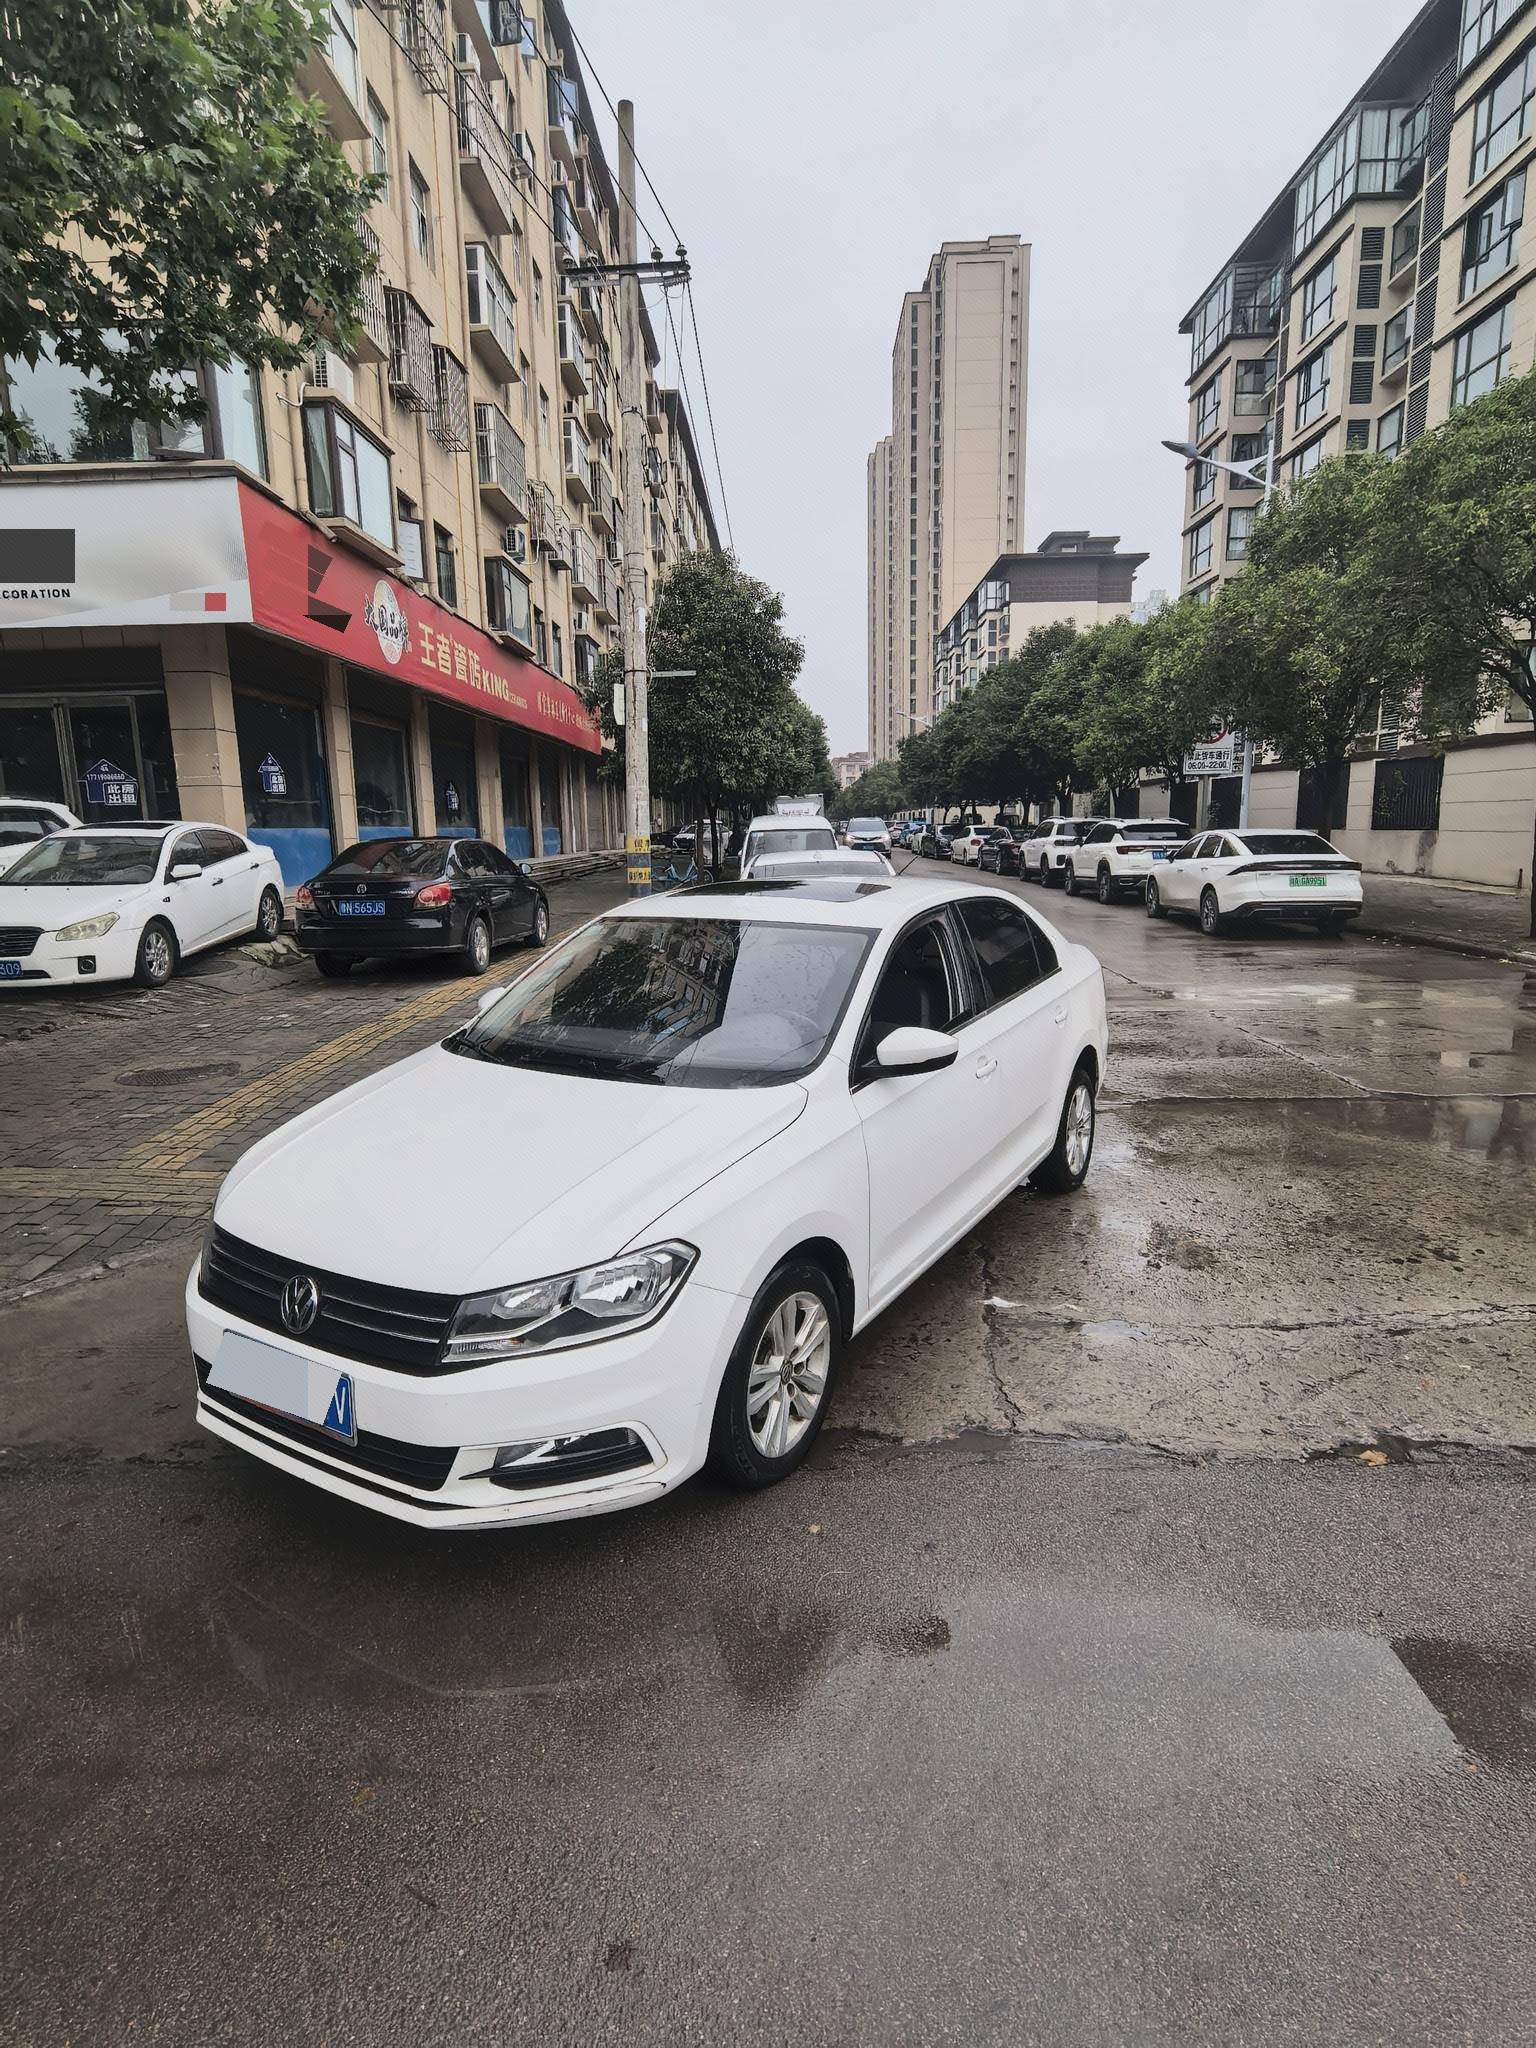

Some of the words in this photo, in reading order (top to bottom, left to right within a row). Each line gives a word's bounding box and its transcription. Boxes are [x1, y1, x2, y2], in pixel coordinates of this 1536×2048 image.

[2, 588, 71, 599] CORATION
[482, 666, 510, 703] KING
[108, 793, 137, 804] 出租
[340, 902, 385, 914] N·565JS
